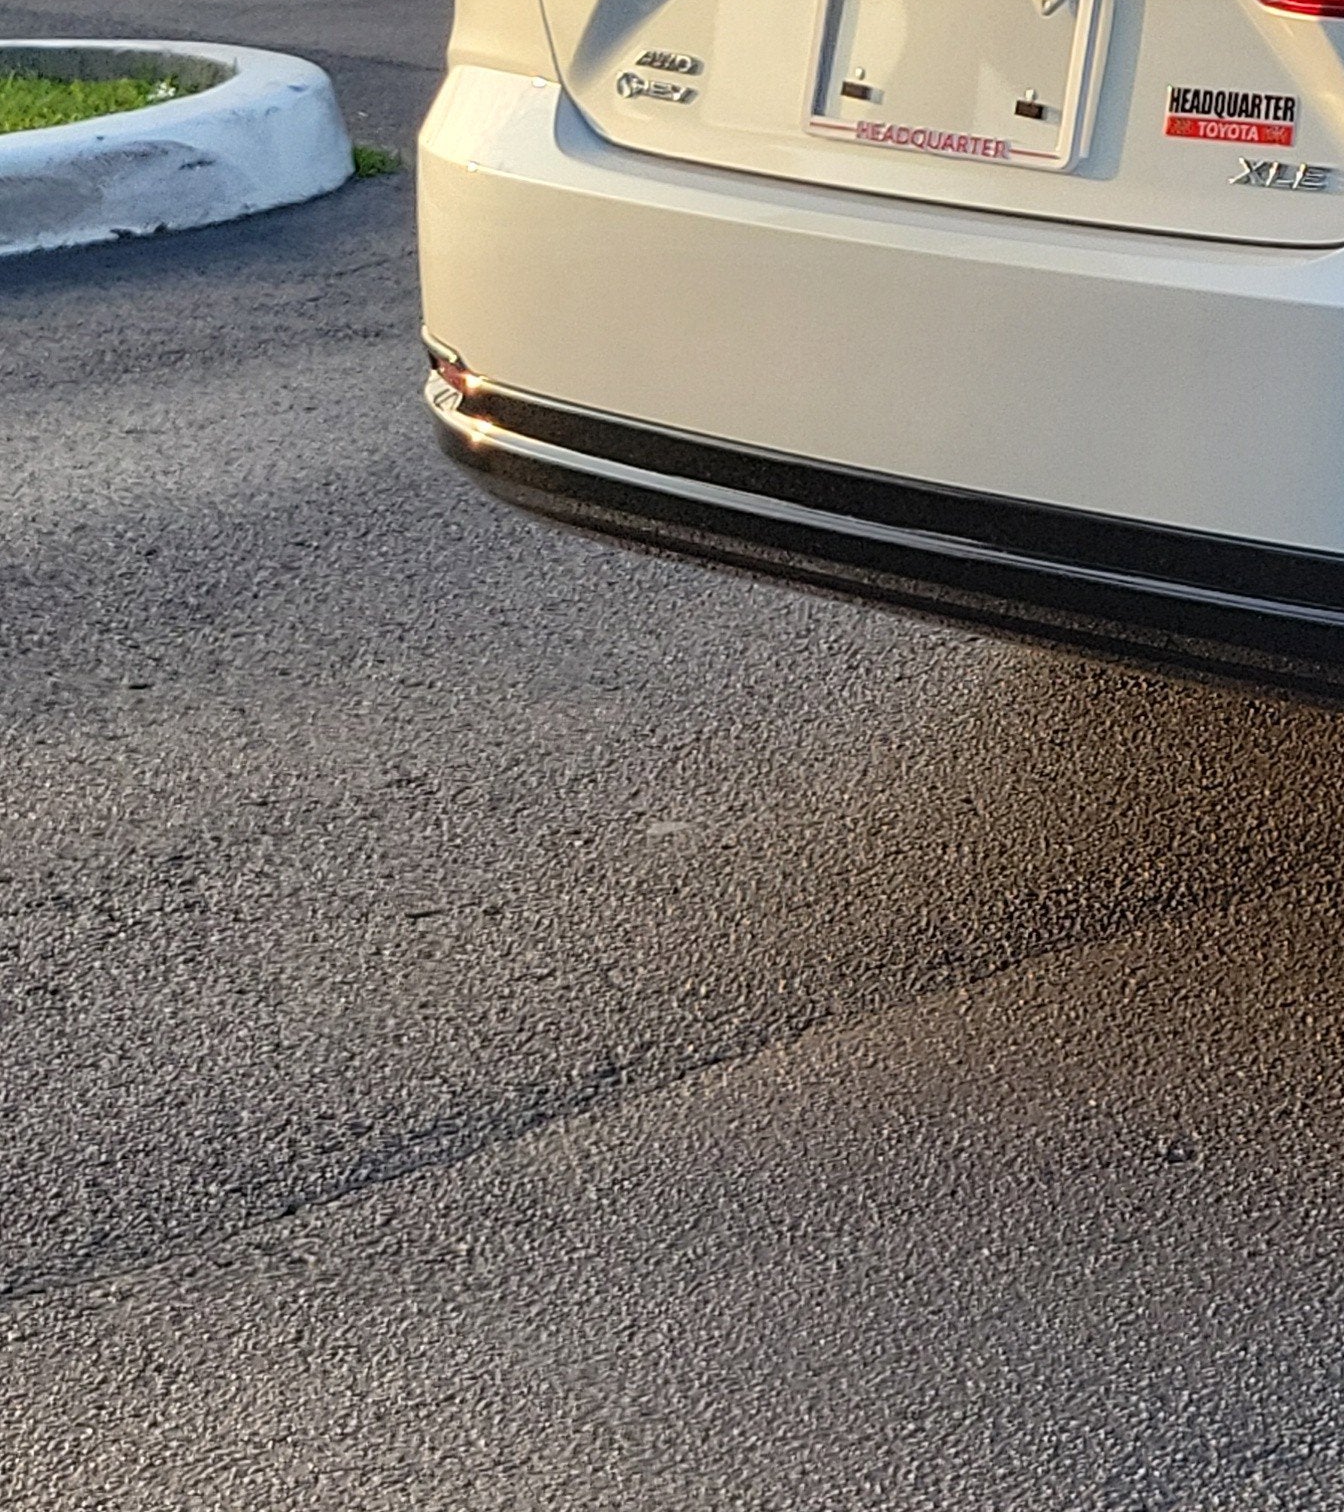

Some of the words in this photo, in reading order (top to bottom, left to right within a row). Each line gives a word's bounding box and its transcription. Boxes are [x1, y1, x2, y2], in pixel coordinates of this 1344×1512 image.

[635, 50, 696, 74] AWD
[1169, 87, 1296, 122] HEADQUARTER
[856, 120, 1010, 159] HEADQUARTER
[1198, 120, 1259, 141] TOYOTA
[1228, 156, 1332, 191] XLE
